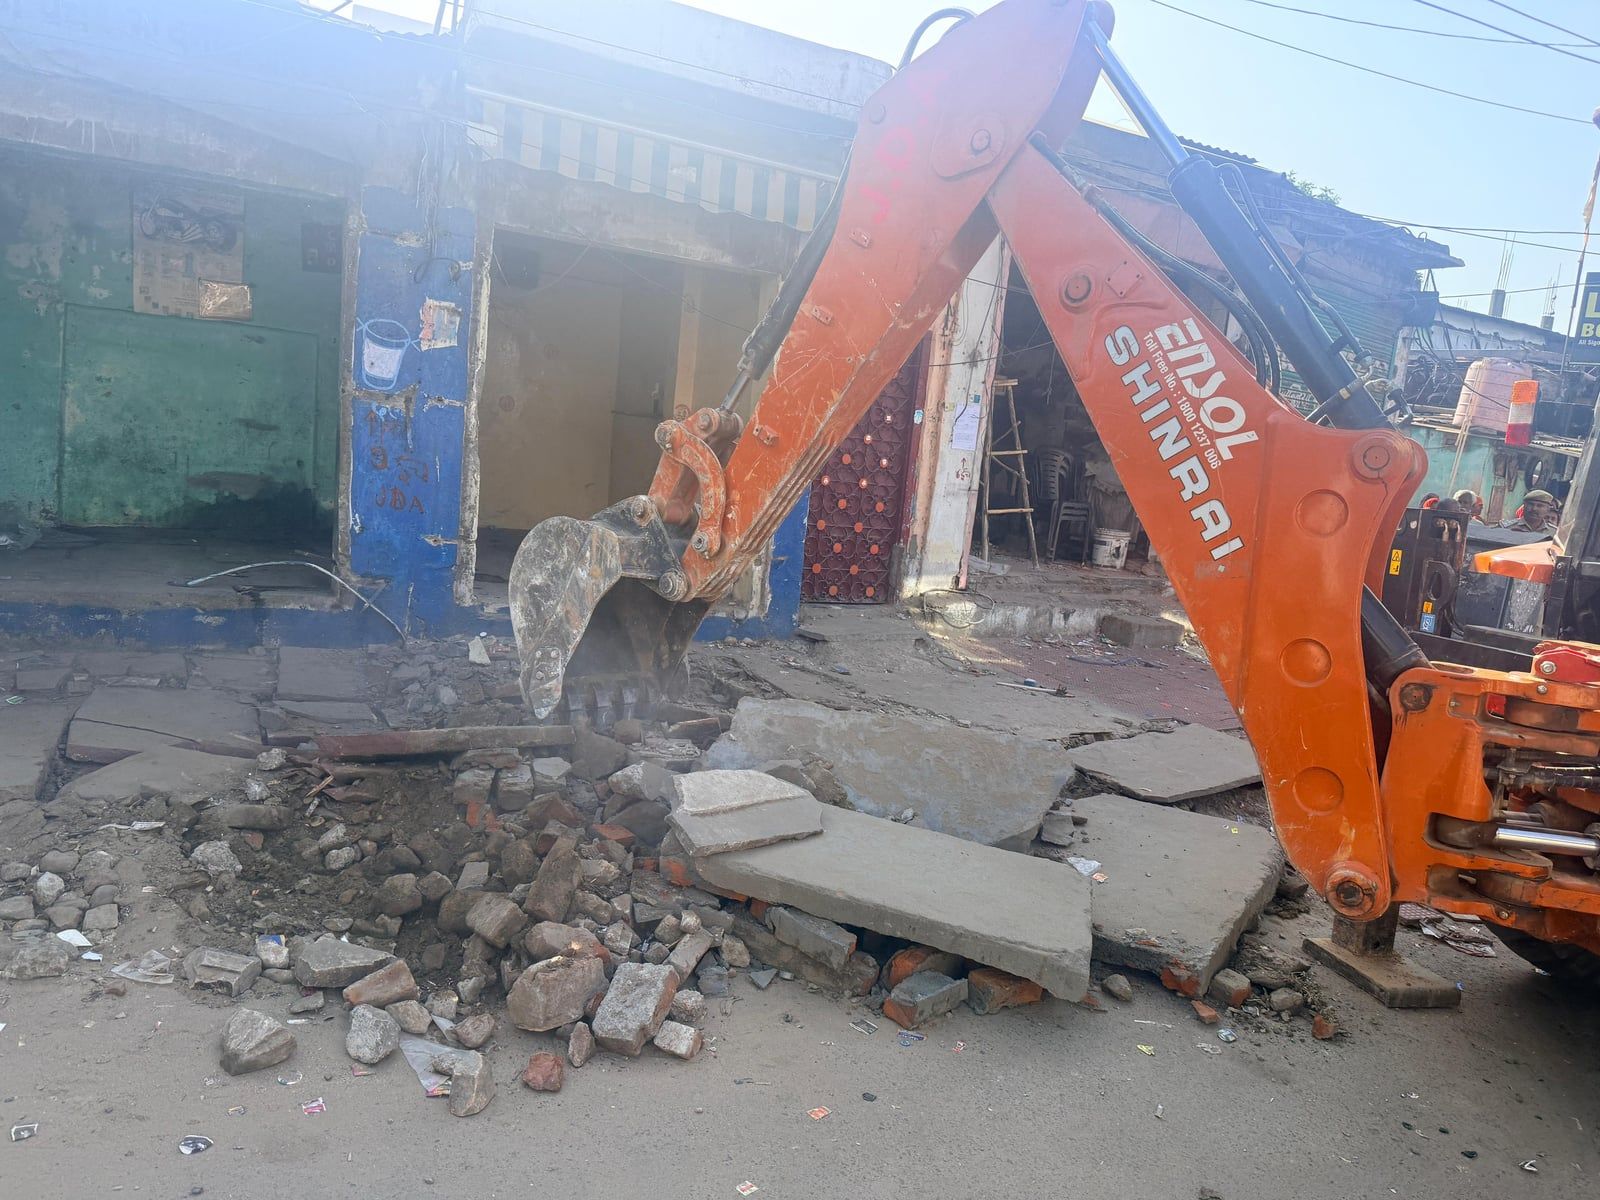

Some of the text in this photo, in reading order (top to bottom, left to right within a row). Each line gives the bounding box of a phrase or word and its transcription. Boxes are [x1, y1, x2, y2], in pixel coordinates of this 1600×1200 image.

[1104, 325, 1245, 561] SHINRAI
[1144, 332, 1159, 352] Toll
[1152, 350, 1169, 374] Free
[1164, 372, 1177, 391] No.
[1177, 396, 1197, 423] 1800
[1190, 422, 1211, 447] 1237
[1204, 448, 1222, 469] 006
[1154, 318, 1259, 460] ENSOL
